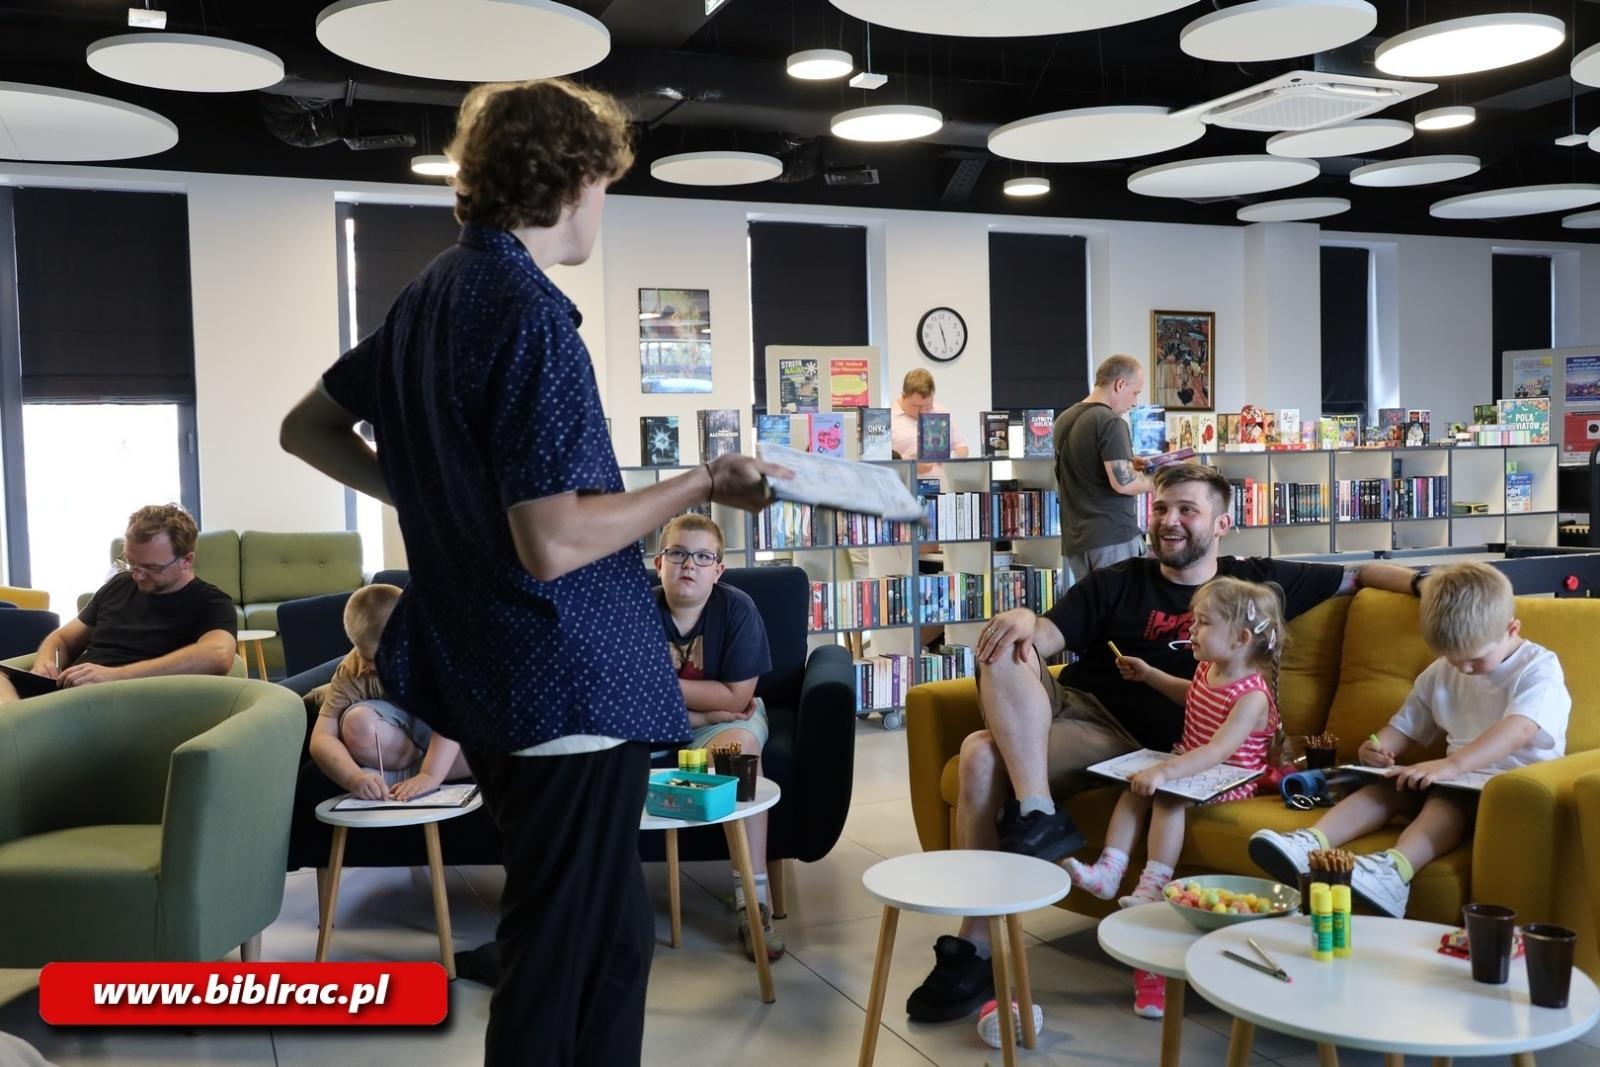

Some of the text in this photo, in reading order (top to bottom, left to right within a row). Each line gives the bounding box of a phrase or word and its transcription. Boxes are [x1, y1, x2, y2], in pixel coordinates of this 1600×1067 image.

[780, 360, 802, 369] STREFA
[1515, 413, 1534, 421] POLA
[867, 424, 887, 433] ONYX
